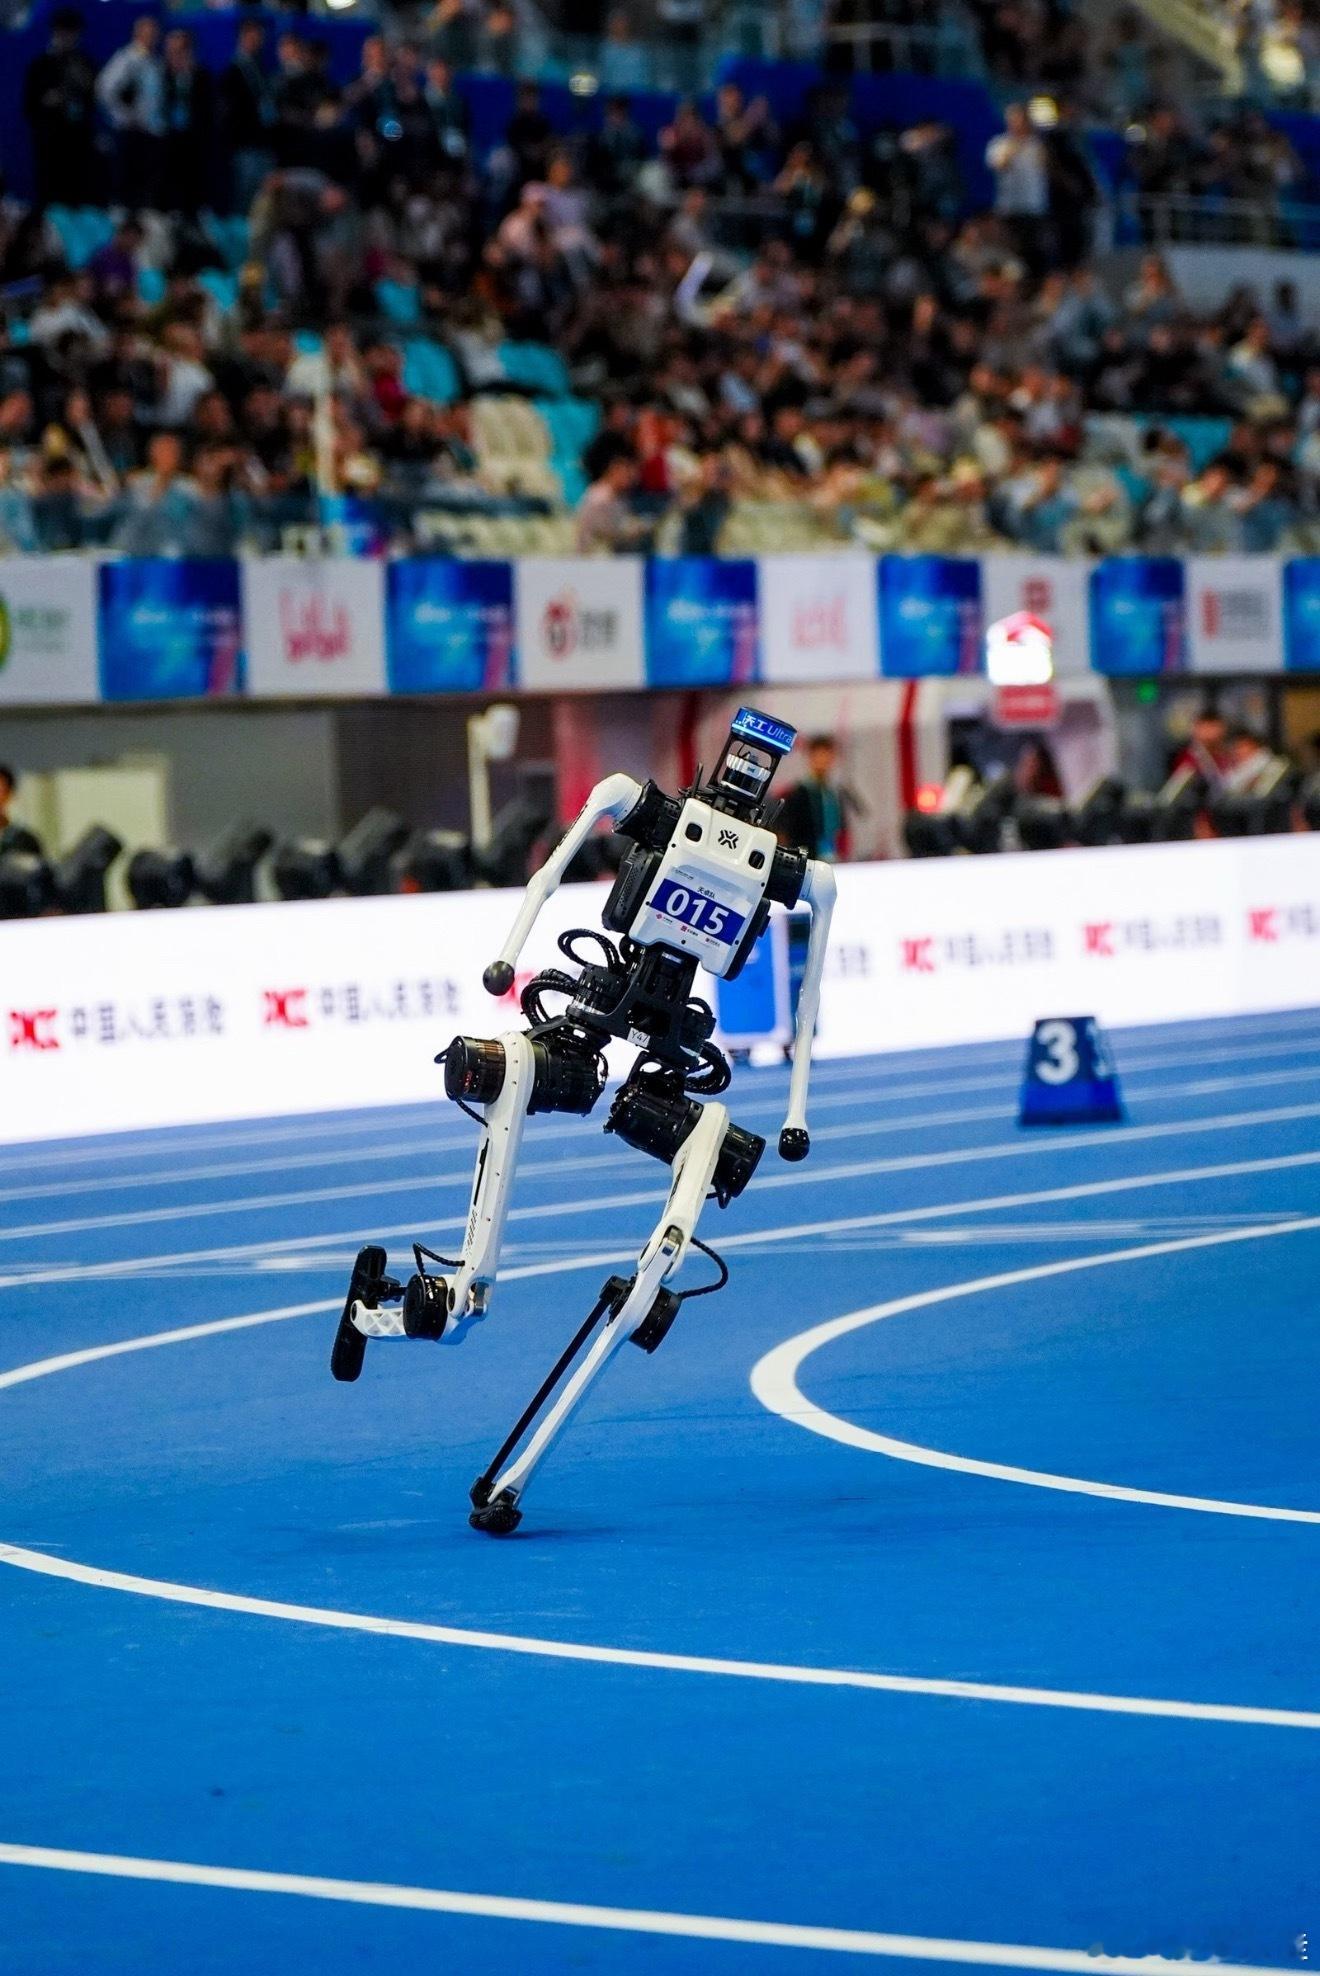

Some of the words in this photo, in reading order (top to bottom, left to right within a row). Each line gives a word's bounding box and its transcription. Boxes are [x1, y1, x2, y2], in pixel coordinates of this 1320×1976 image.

[767, 725, 793, 744] Ultra
[666, 888, 730, 935] 015
[1035, 1020, 1079, 1085] 3
